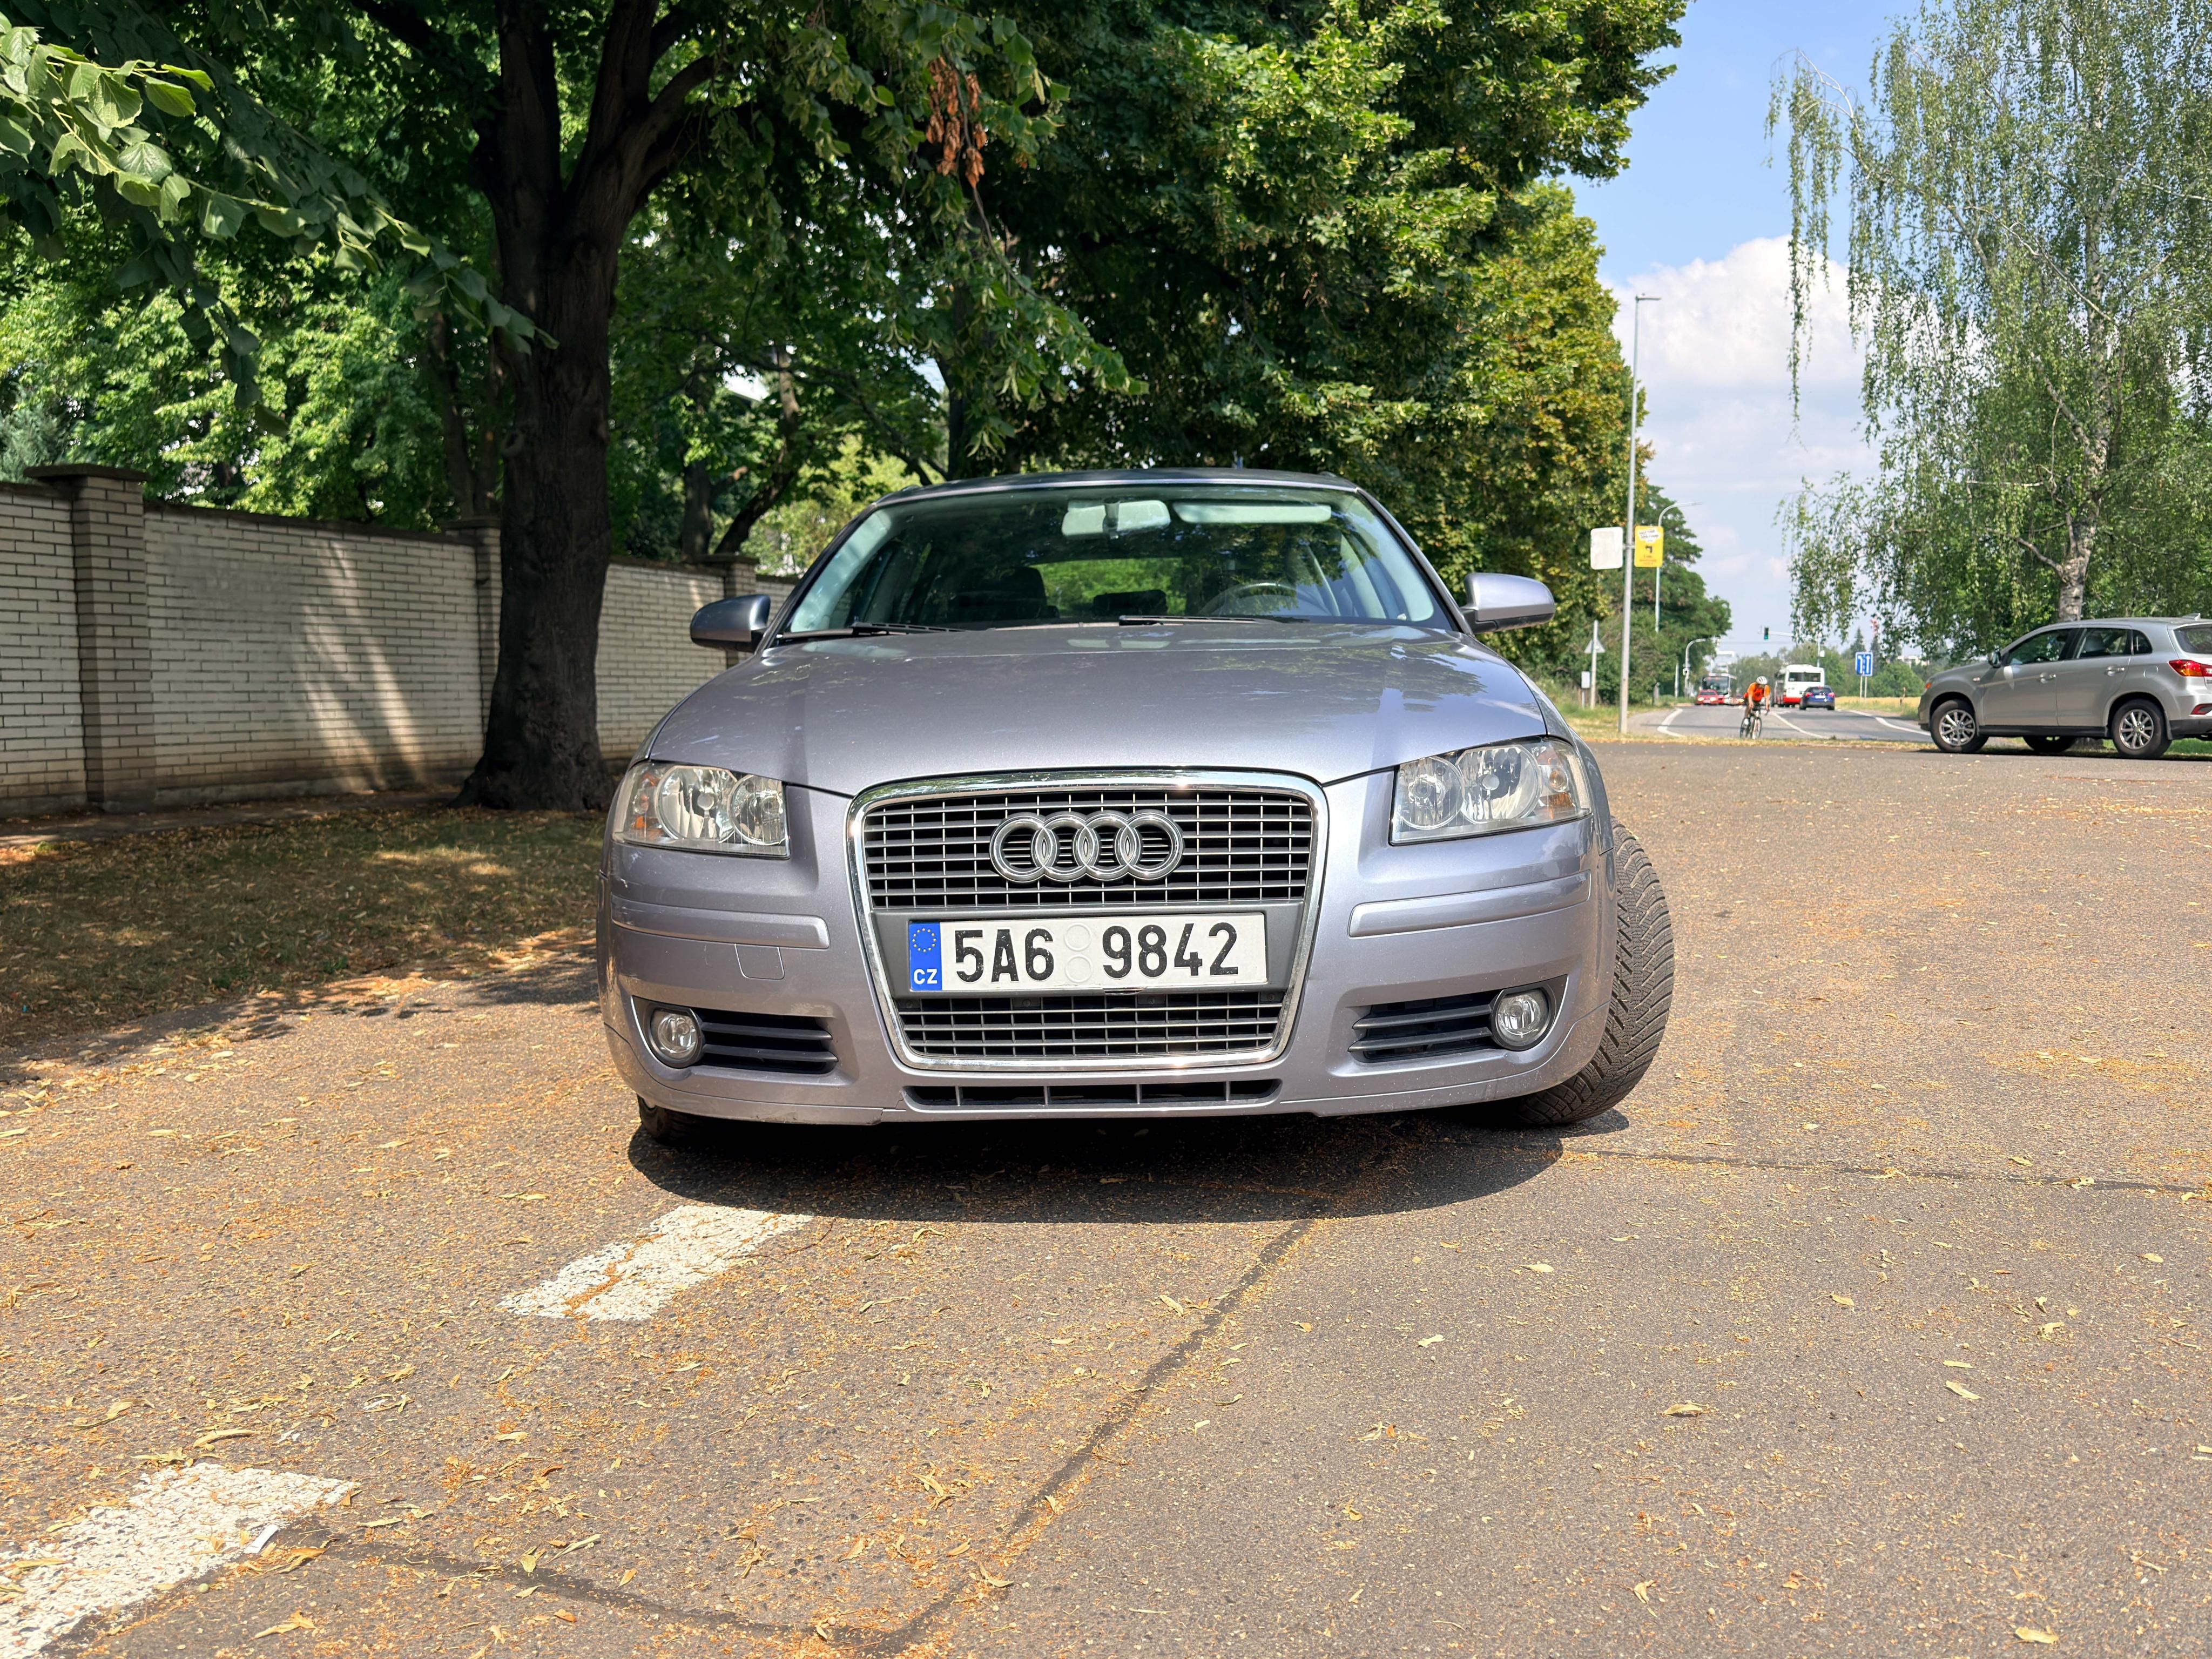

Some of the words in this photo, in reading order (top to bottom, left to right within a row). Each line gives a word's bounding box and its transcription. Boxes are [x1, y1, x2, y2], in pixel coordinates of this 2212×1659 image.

[955, 928, 1054, 982] 5A6
[1102, 922, 1238, 979] 9842
[913, 968, 938, 984] CZ
